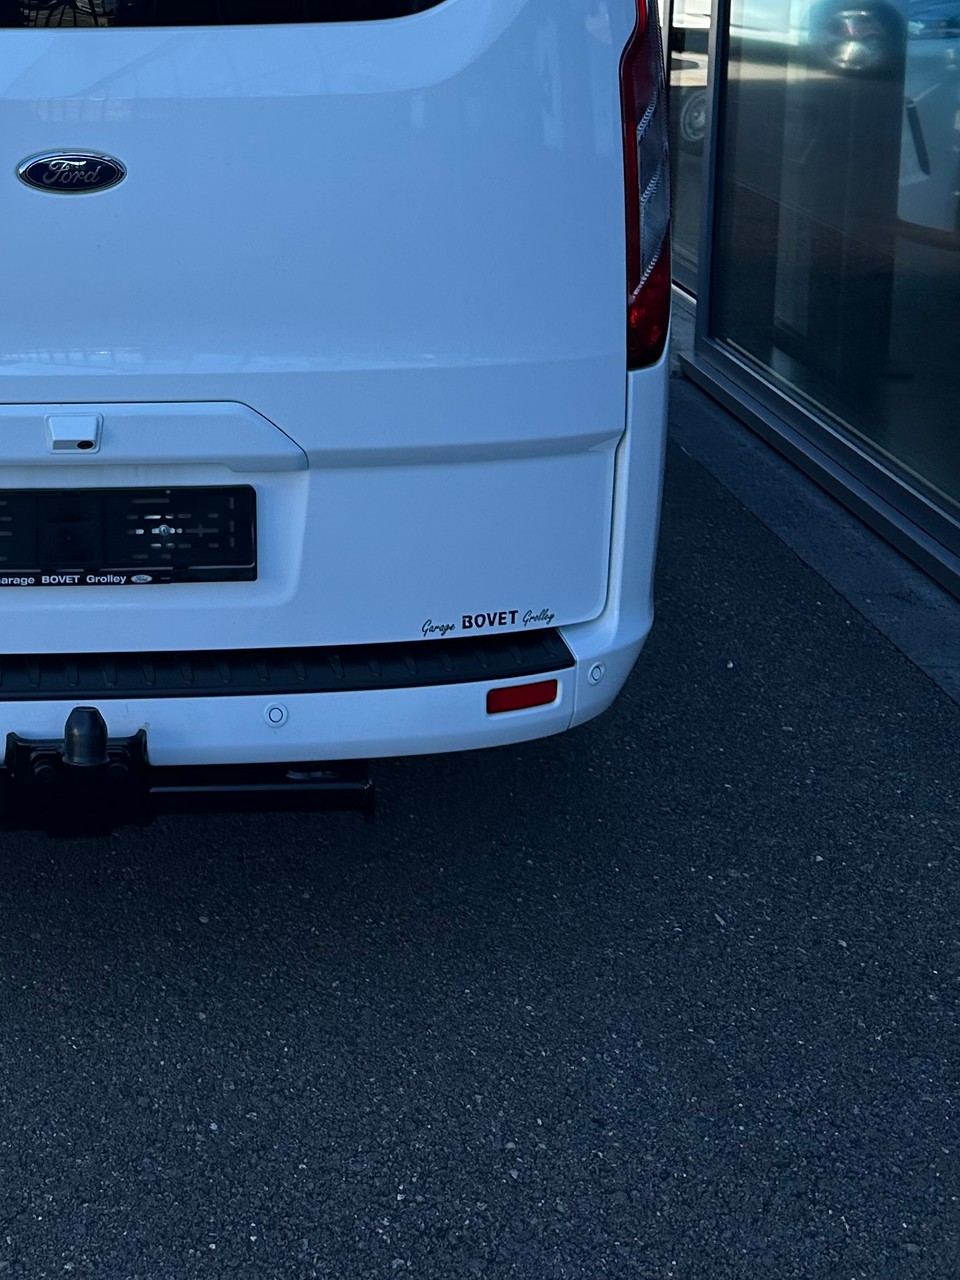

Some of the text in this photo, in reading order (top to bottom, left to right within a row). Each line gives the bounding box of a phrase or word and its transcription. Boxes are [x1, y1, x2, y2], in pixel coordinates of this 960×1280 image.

[43, 160, 101, 184] Ford
[41, 575, 80, 584] BOVET
[86, 574, 127, 585] Grolley
[421, 608, 555, 637] Garage BOVET Grolley
